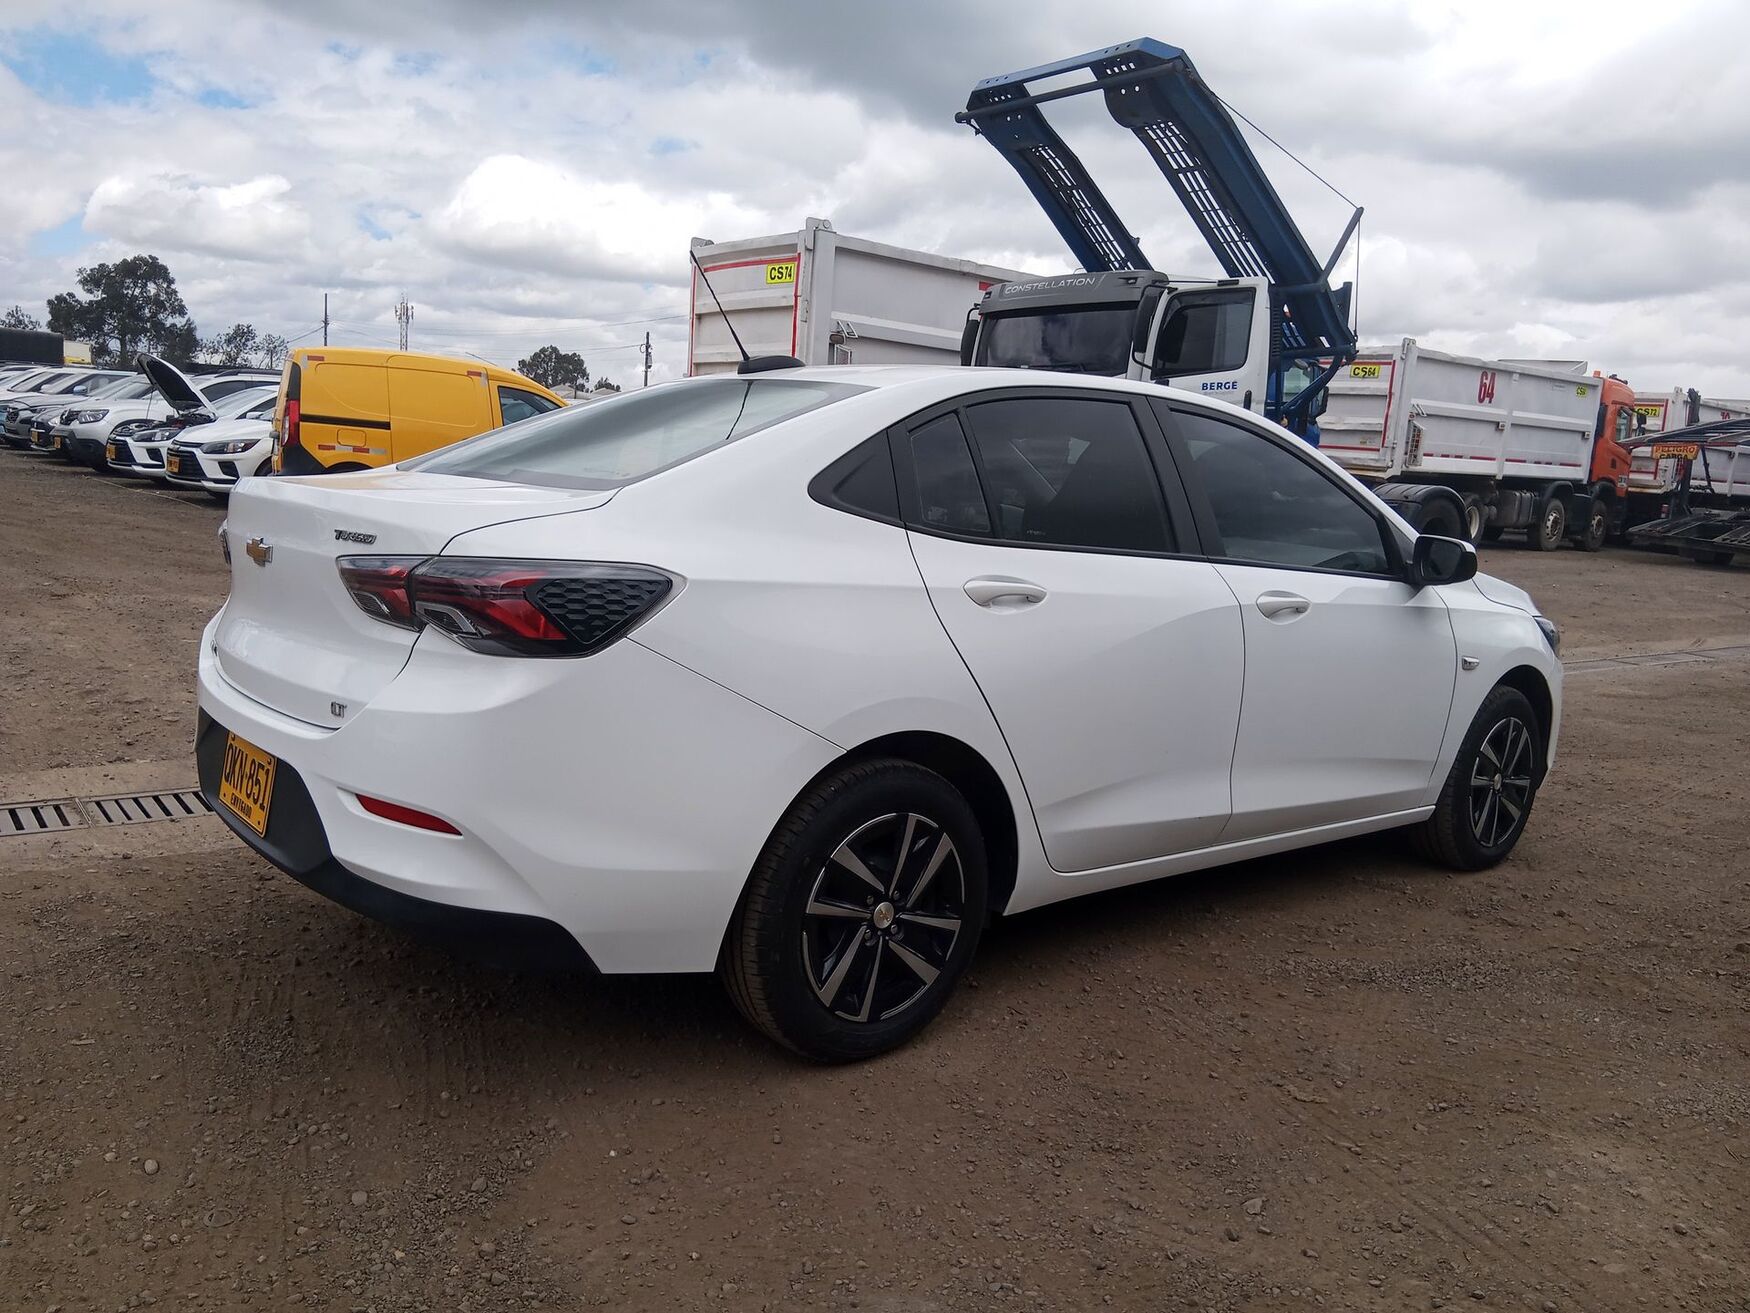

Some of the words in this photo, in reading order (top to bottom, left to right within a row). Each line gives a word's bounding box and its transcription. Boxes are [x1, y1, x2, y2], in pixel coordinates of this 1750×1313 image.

[770, 265, 792, 281] CS74
[1004, 277, 1096, 295] CONSTELLATION
[1353, 366, 1376, 377] CS64
[1478, 370, 1496, 404] 64
[1655, 445, 1696, 454] PELIGRO
[331, 701, 347, 719] LT
